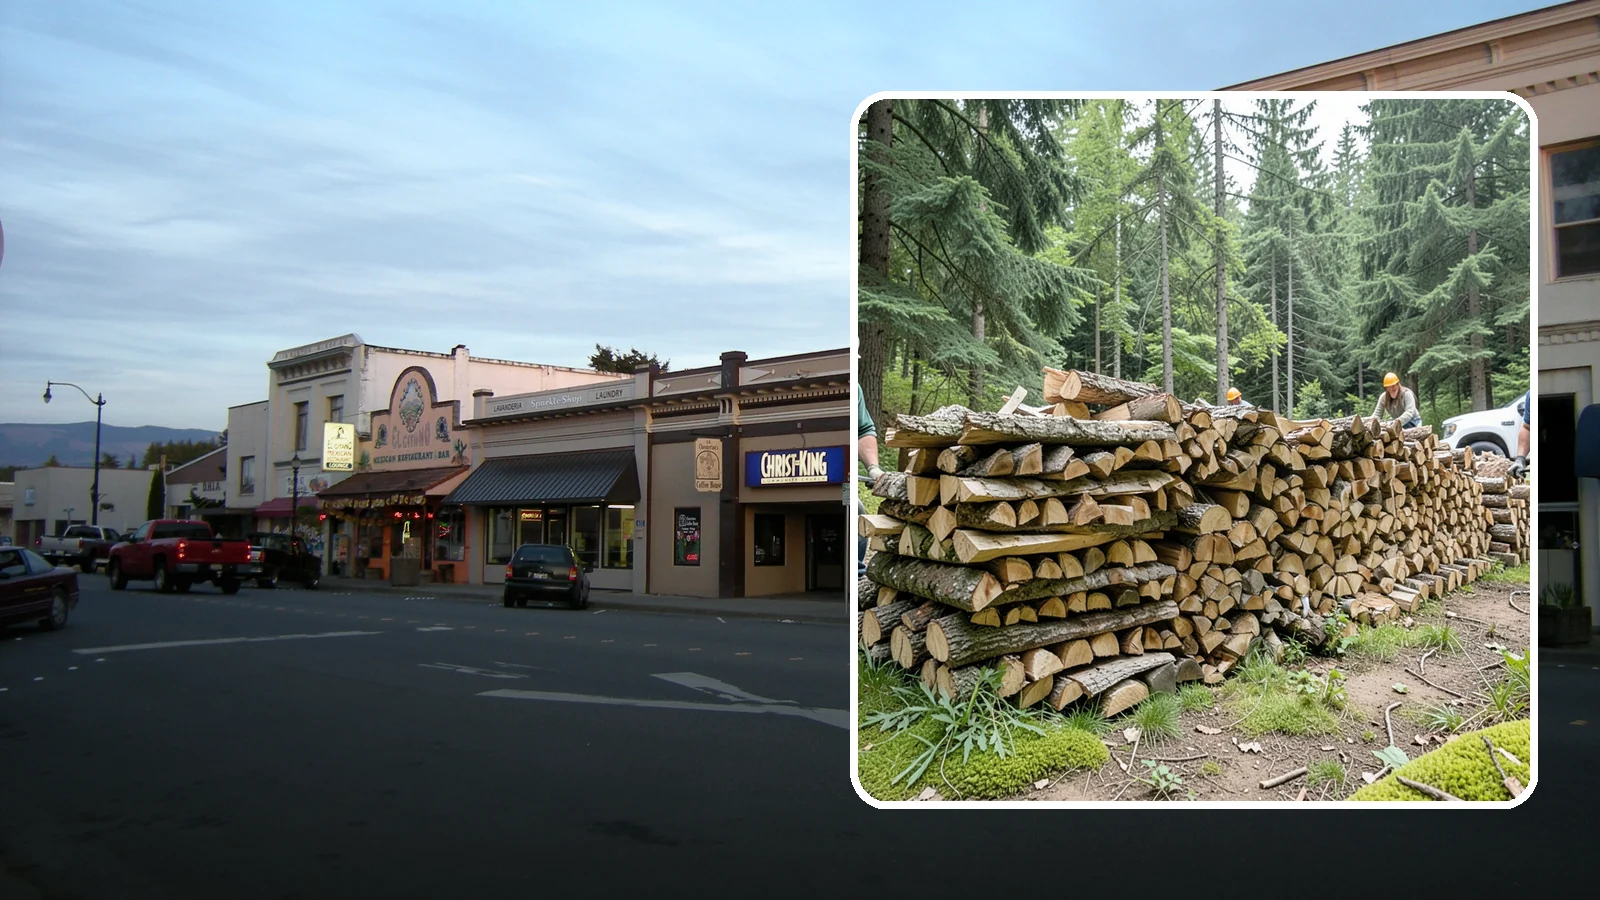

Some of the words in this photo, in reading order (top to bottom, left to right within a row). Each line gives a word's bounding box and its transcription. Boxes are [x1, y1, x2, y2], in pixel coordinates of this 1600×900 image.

[493, 402, 523, 413] LAVANDERIA
[530, 397, 561, 409] Sparkle
[562, 394, 582, 404] Shop
[595, 389, 624, 400] LAUNDRY
[373, 455, 397, 464] MEXICAN
[397, 451, 433, 462] RESTAURANT
[437, 450, 450, 459] BAR
[761, 452, 797, 478] CHRIST
[799, 450, 827, 476] KING
